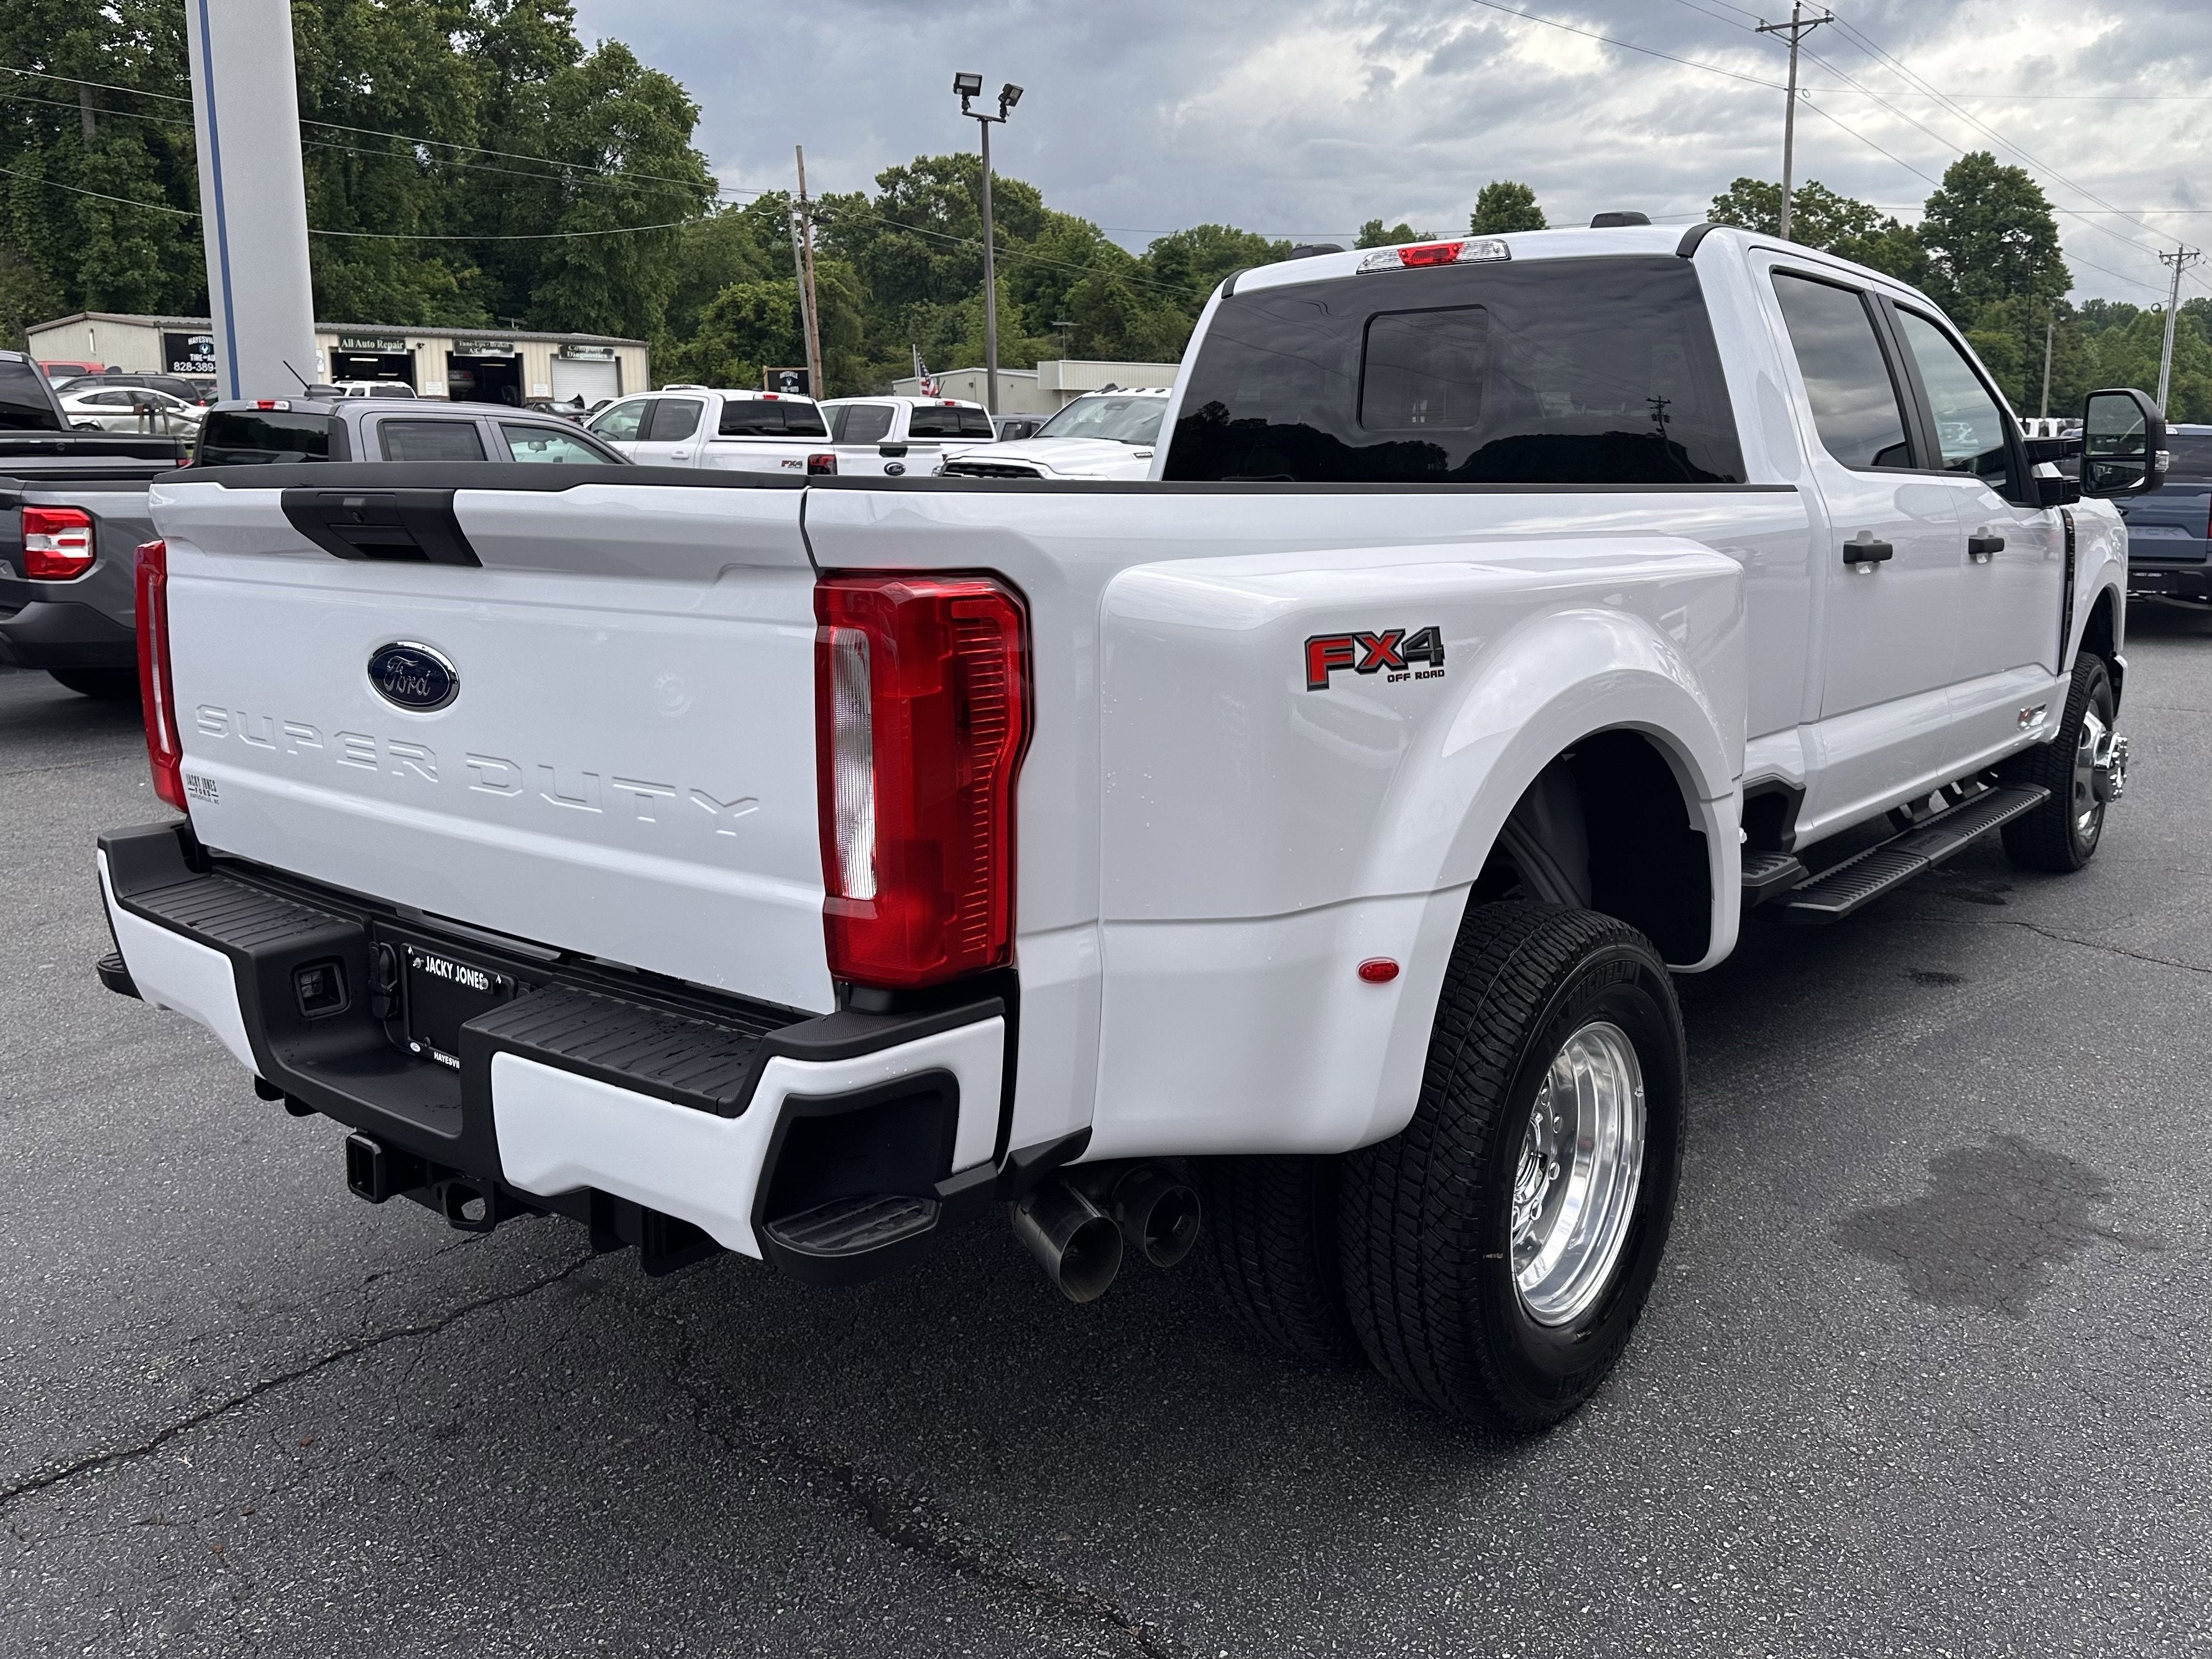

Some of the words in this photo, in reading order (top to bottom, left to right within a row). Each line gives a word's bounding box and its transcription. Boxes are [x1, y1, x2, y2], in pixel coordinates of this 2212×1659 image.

[341, 338, 354, 348] All
[355, 339, 376, 349] Auto
[377, 339, 404, 351] Repair
[1304, 626, 1445, 691] FX4
[383, 655, 431, 696] Ford
[1387, 673, 1411, 683] OFF
[1415, 669, 1445, 680] ROAD
[186, 773, 201, 788] JACKY
[201, 777, 217, 793] JONES
[196, 703, 438, 783] SUPER
[466, 752, 759, 836] DUTY
[195, 787, 211, 797] FORD
[425, 956, 453, 979] JACKY
[455, 965, 484, 991] JONES
